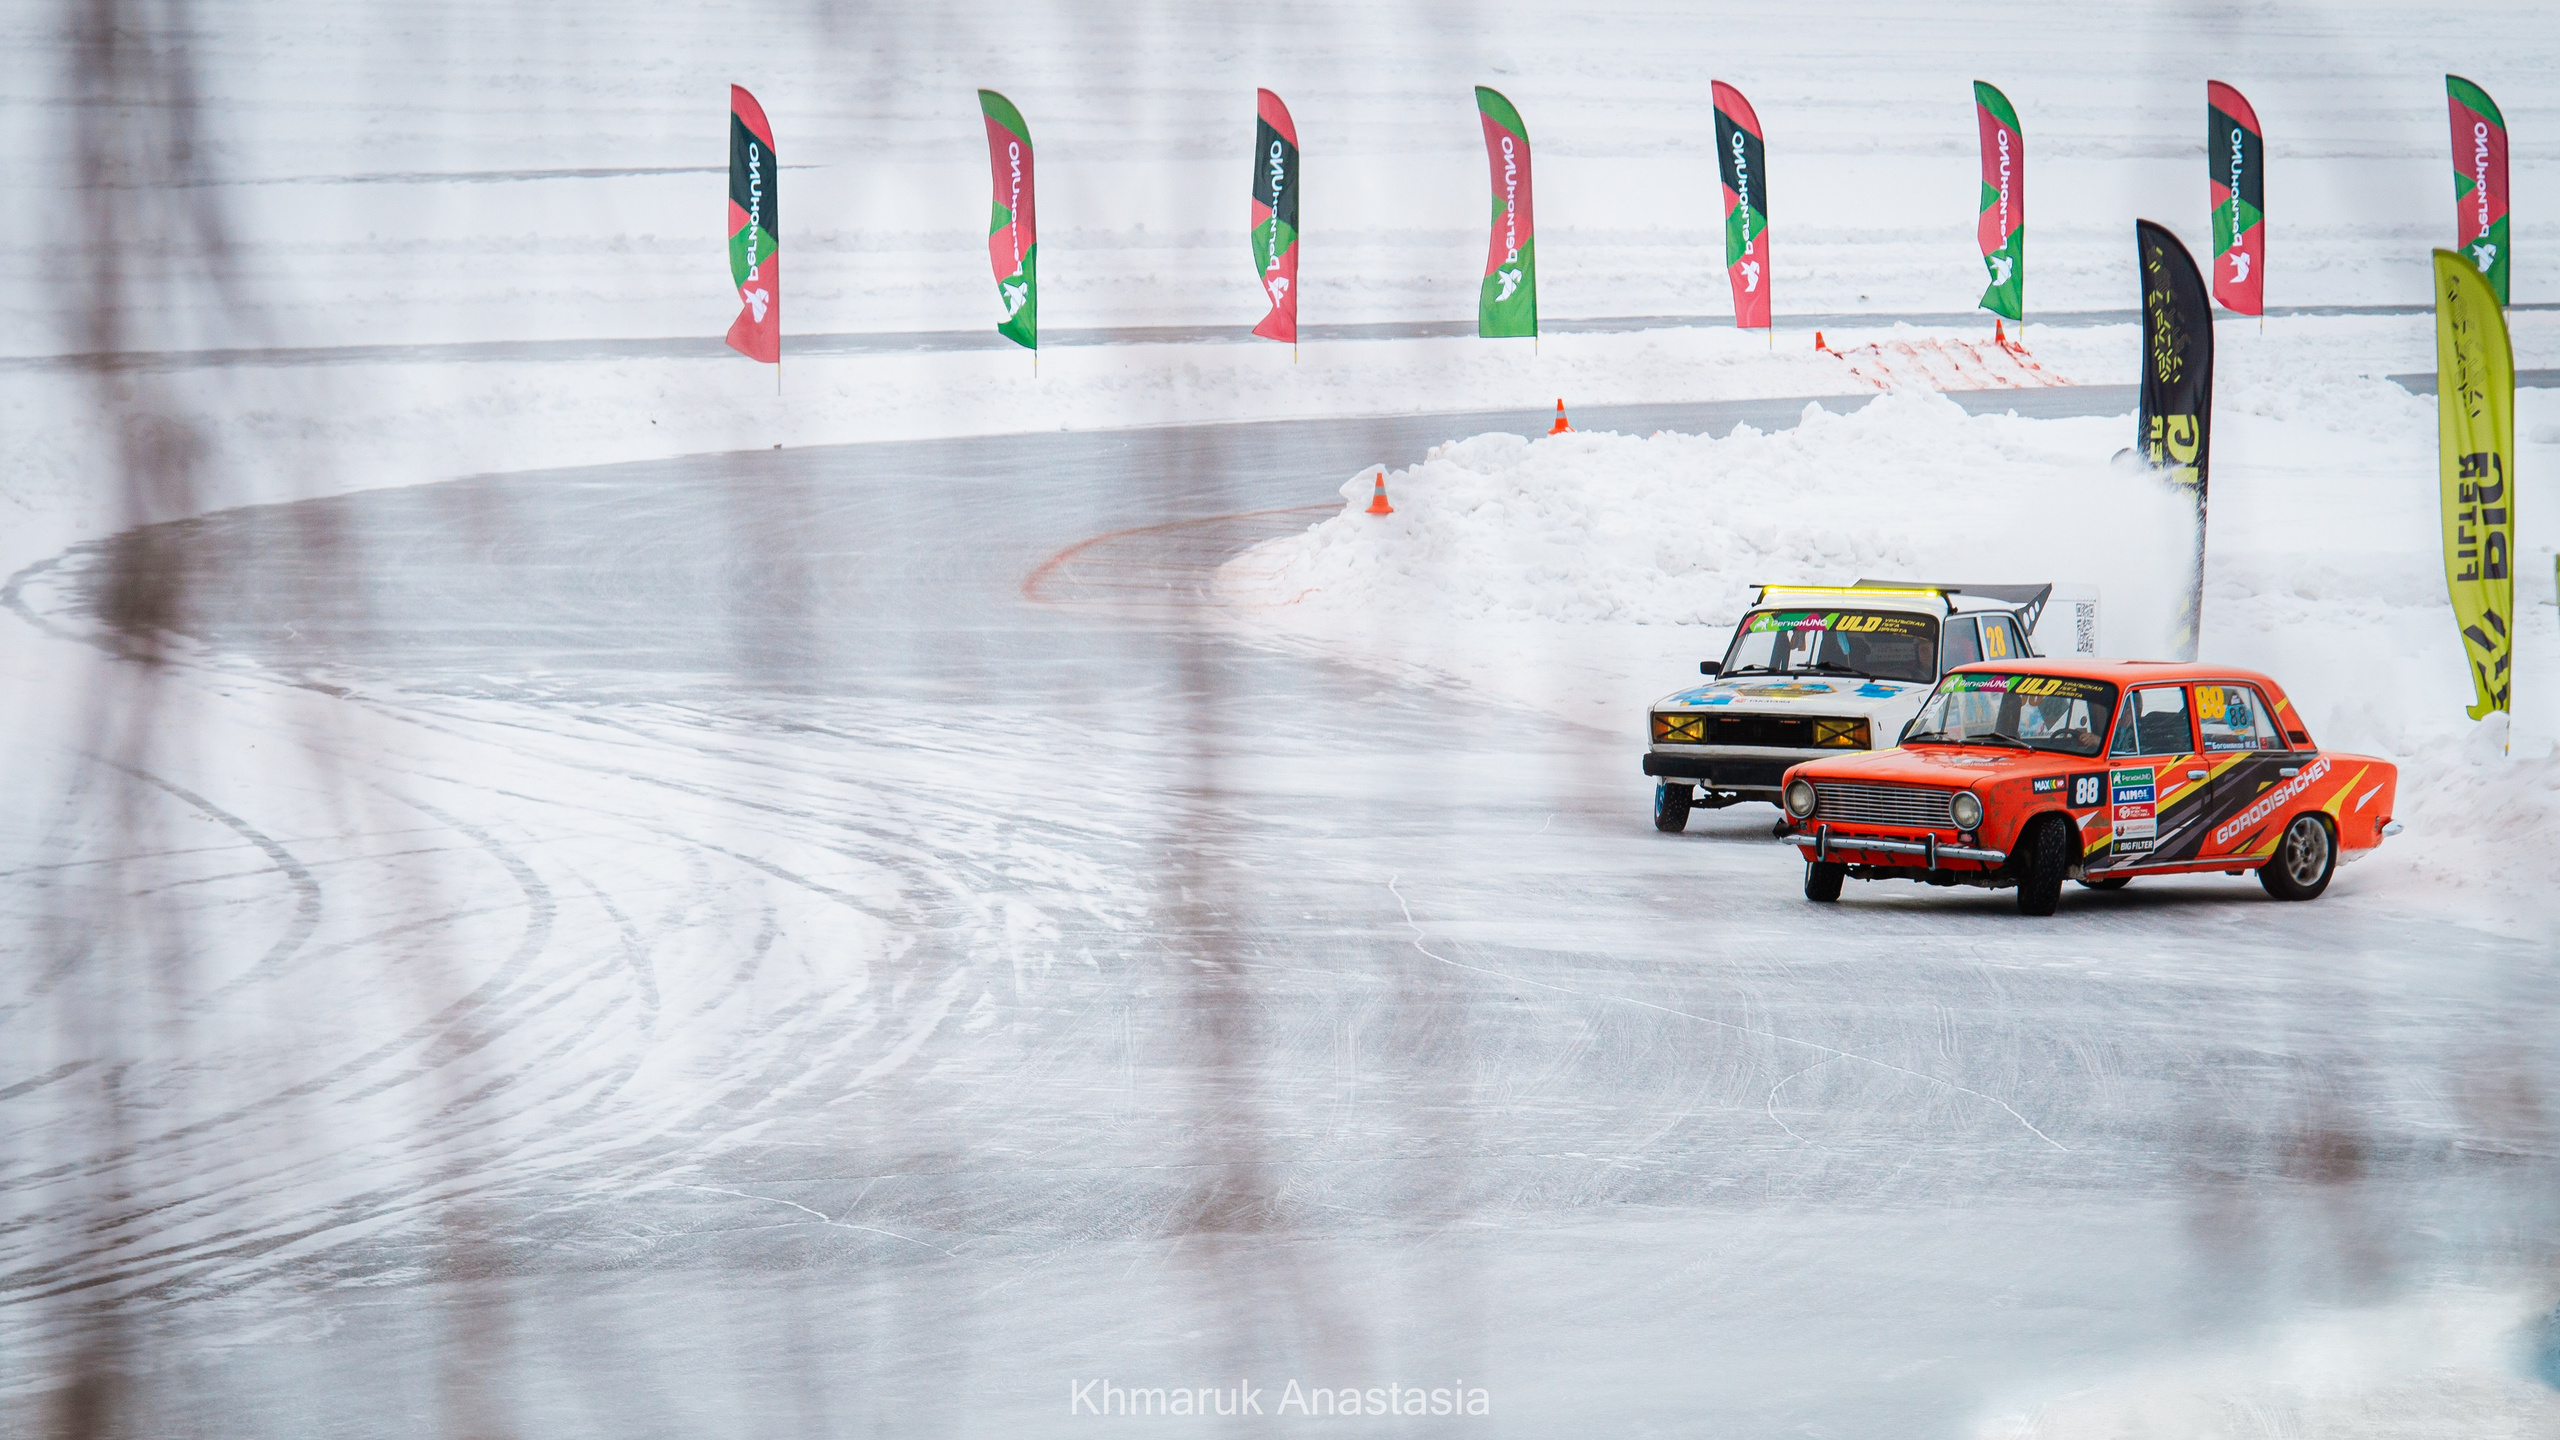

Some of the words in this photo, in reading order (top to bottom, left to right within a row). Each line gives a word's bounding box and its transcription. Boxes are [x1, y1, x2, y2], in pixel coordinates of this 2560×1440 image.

[1835, 616, 1882, 632] ULD
[1985, 626, 2007, 658] 28
[2015, 678, 2062, 695] ULD
[2196, 686, 2225, 719] 88
[2229, 706, 2248, 726] 88
[2076, 777, 2099, 805] 88
[2216, 756, 2332, 845] GORODISHCHEV
[2120, 842, 2132, 851] BIG
[2132, 841, 2153, 850] FILTER
